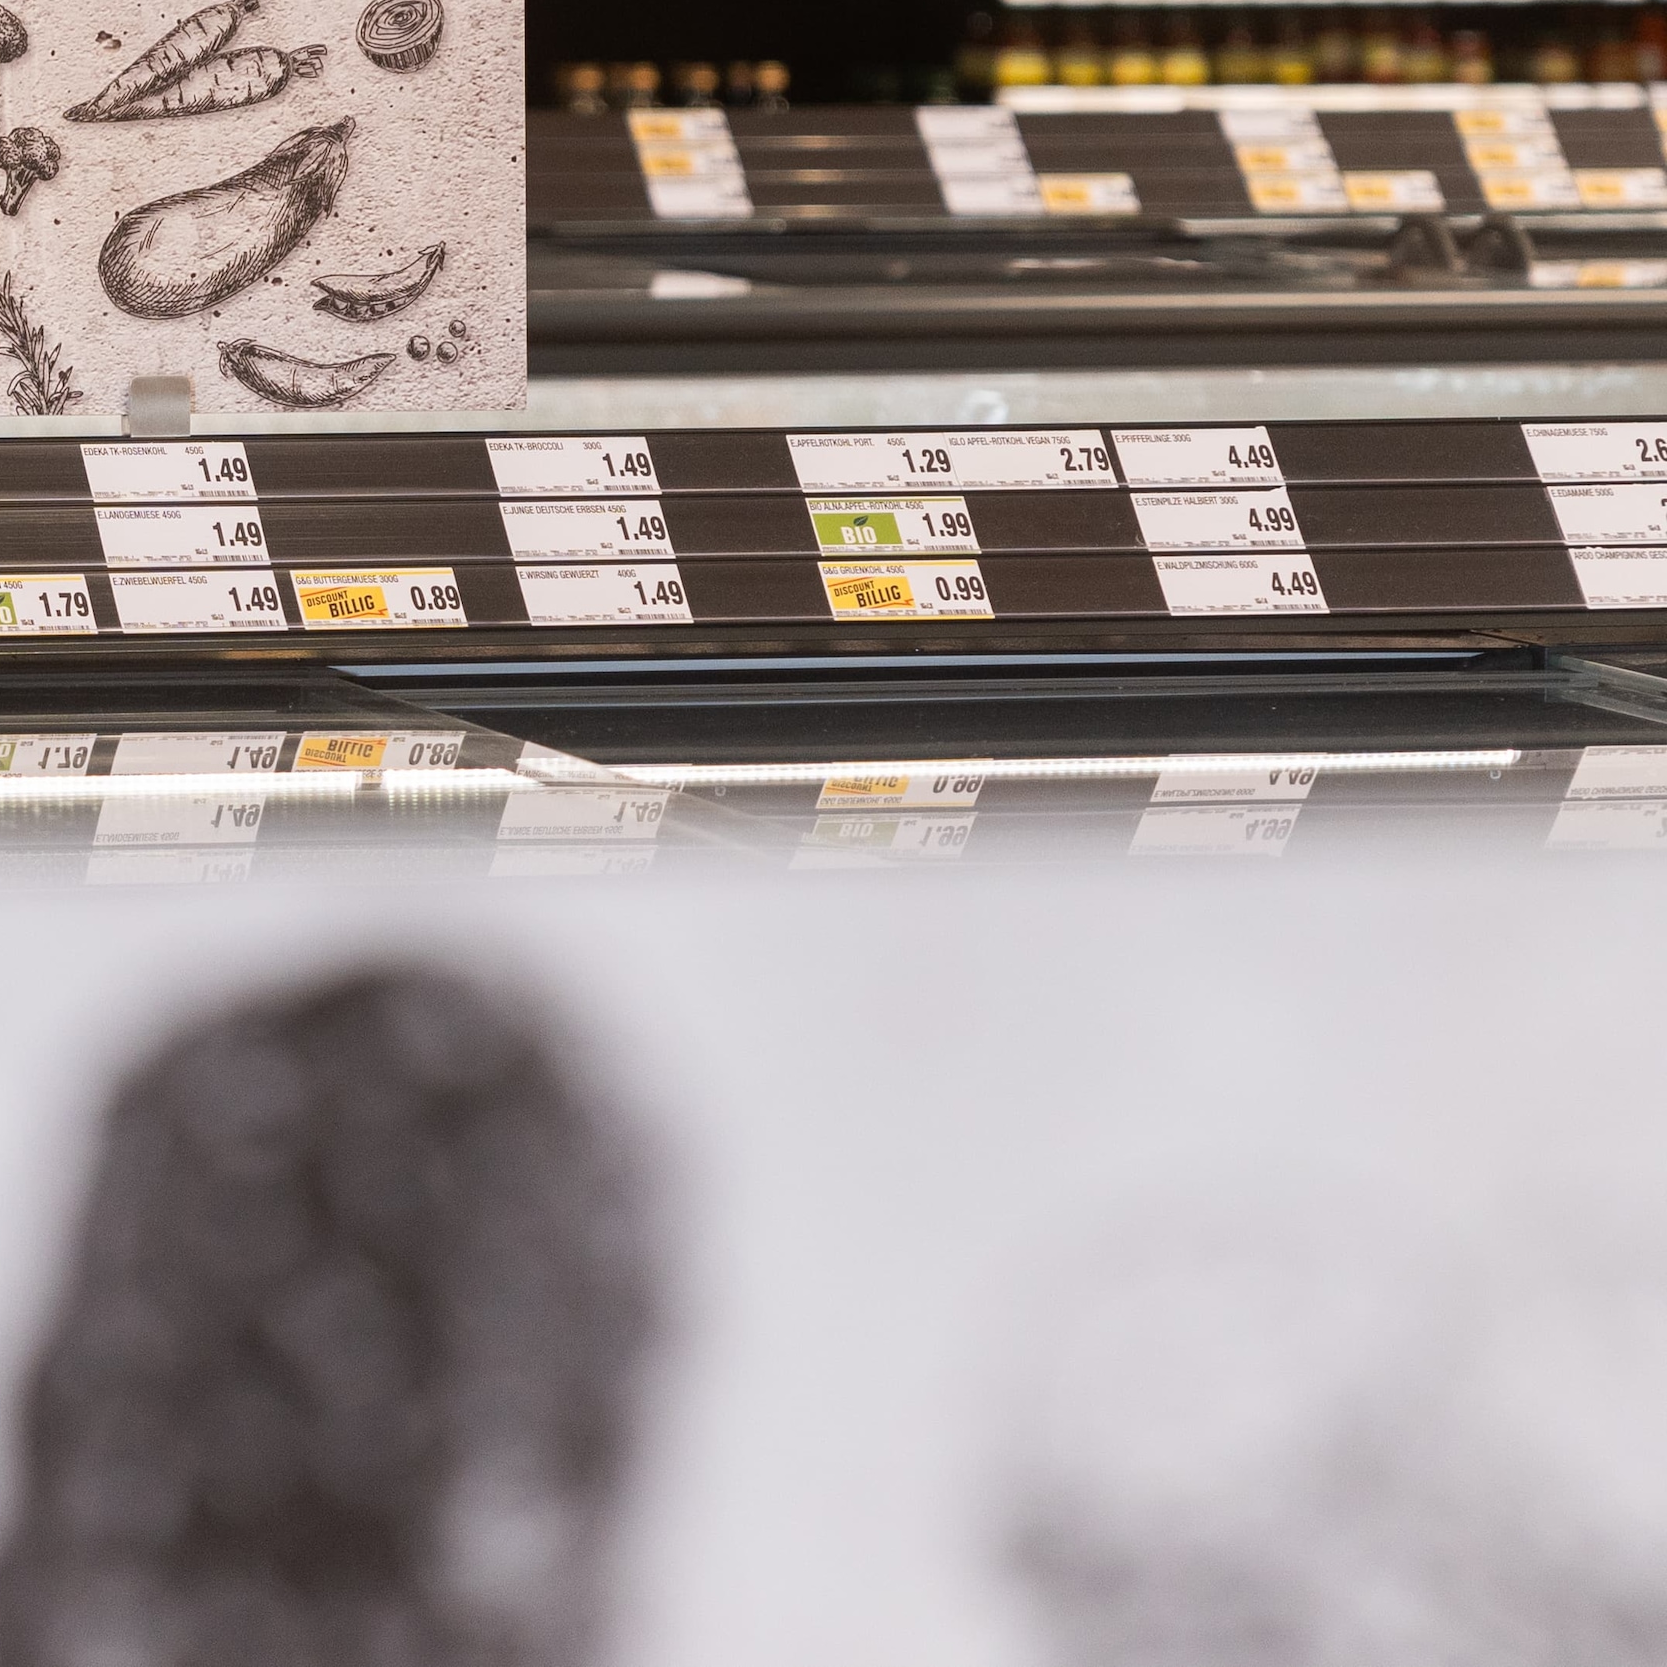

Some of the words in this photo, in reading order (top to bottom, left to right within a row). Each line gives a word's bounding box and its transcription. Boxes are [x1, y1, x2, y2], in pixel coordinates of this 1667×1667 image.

[603, 453, 651, 477] 1.49
[903, 449, 951, 472] 1.29
[1061, 448, 1109, 471] 2.79
[1228, 445, 1273, 468] 4.49
[199, 458, 247, 482] 1.49
[617, 517, 666, 540] 1.49
[923, 513, 972, 537] 1.99
[1249, 508, 1295, 531] 4.99
[213, 522, 262, 546] 1.49
[841, 527, 877, 544] BIO
[634, 581, 684, 605] 1.49
[834, 582, 875, 598] DISCOUNT
[936, 576, 984, 601] 0.99
[1272, 572, 1317, 596] 4.49
[39, 592, 89, 616] 1.79
[229, 587, 278, 611] 1.49
[306, 592, 349, 607] DISCOUNT
[329, 595, 375, 617] BILLIG
[411, 585, 460, 610] 0.89
[856, 586, 901, 608] BILLIG
